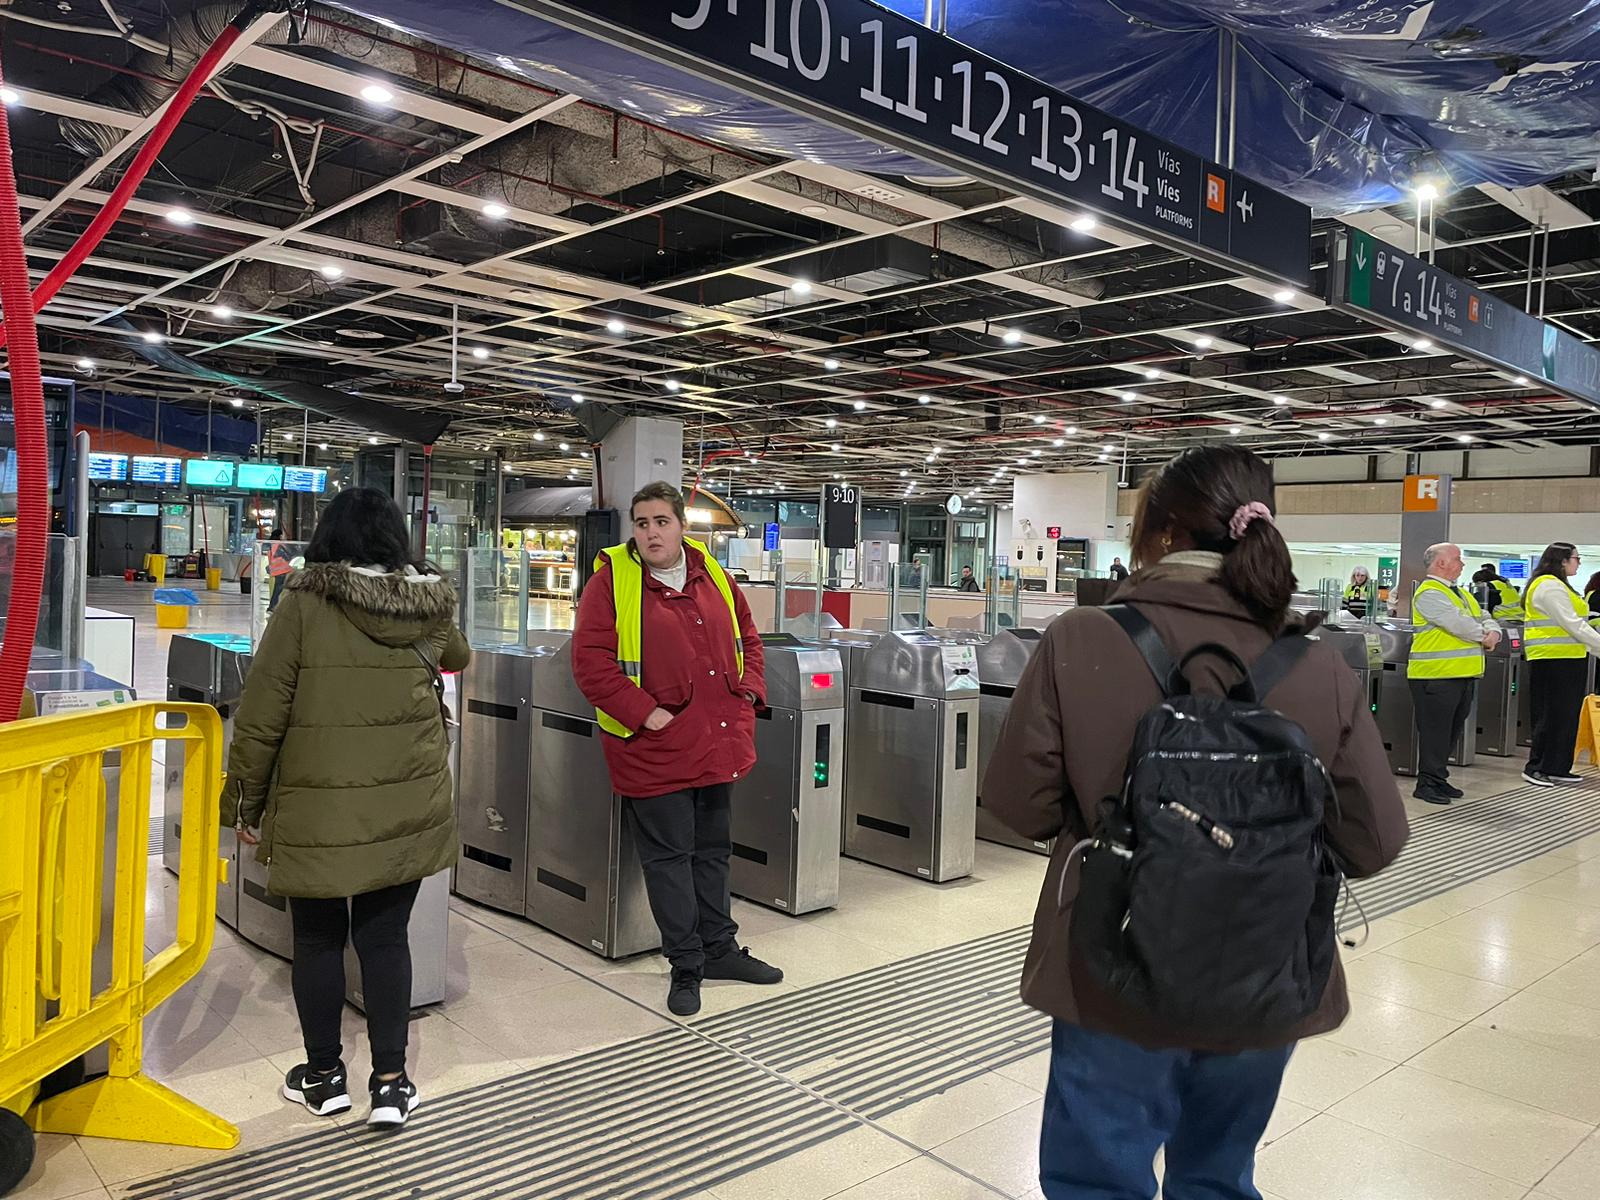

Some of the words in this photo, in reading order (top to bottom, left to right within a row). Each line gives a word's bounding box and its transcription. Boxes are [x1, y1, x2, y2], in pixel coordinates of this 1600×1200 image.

[1158, 149, 1181, 176] Vías
[1157, 177, 1180, 203] Vies
[1155, 205, 1193, 229] PLATFORMS
[1391, 255, 1404, 307] 7
[1403, 291, 1412, 313] a
[1416, 270, 1442, 326] 14
[1417, 479, 1440, 499] R
[1382, 568, 1393, 578] 13
